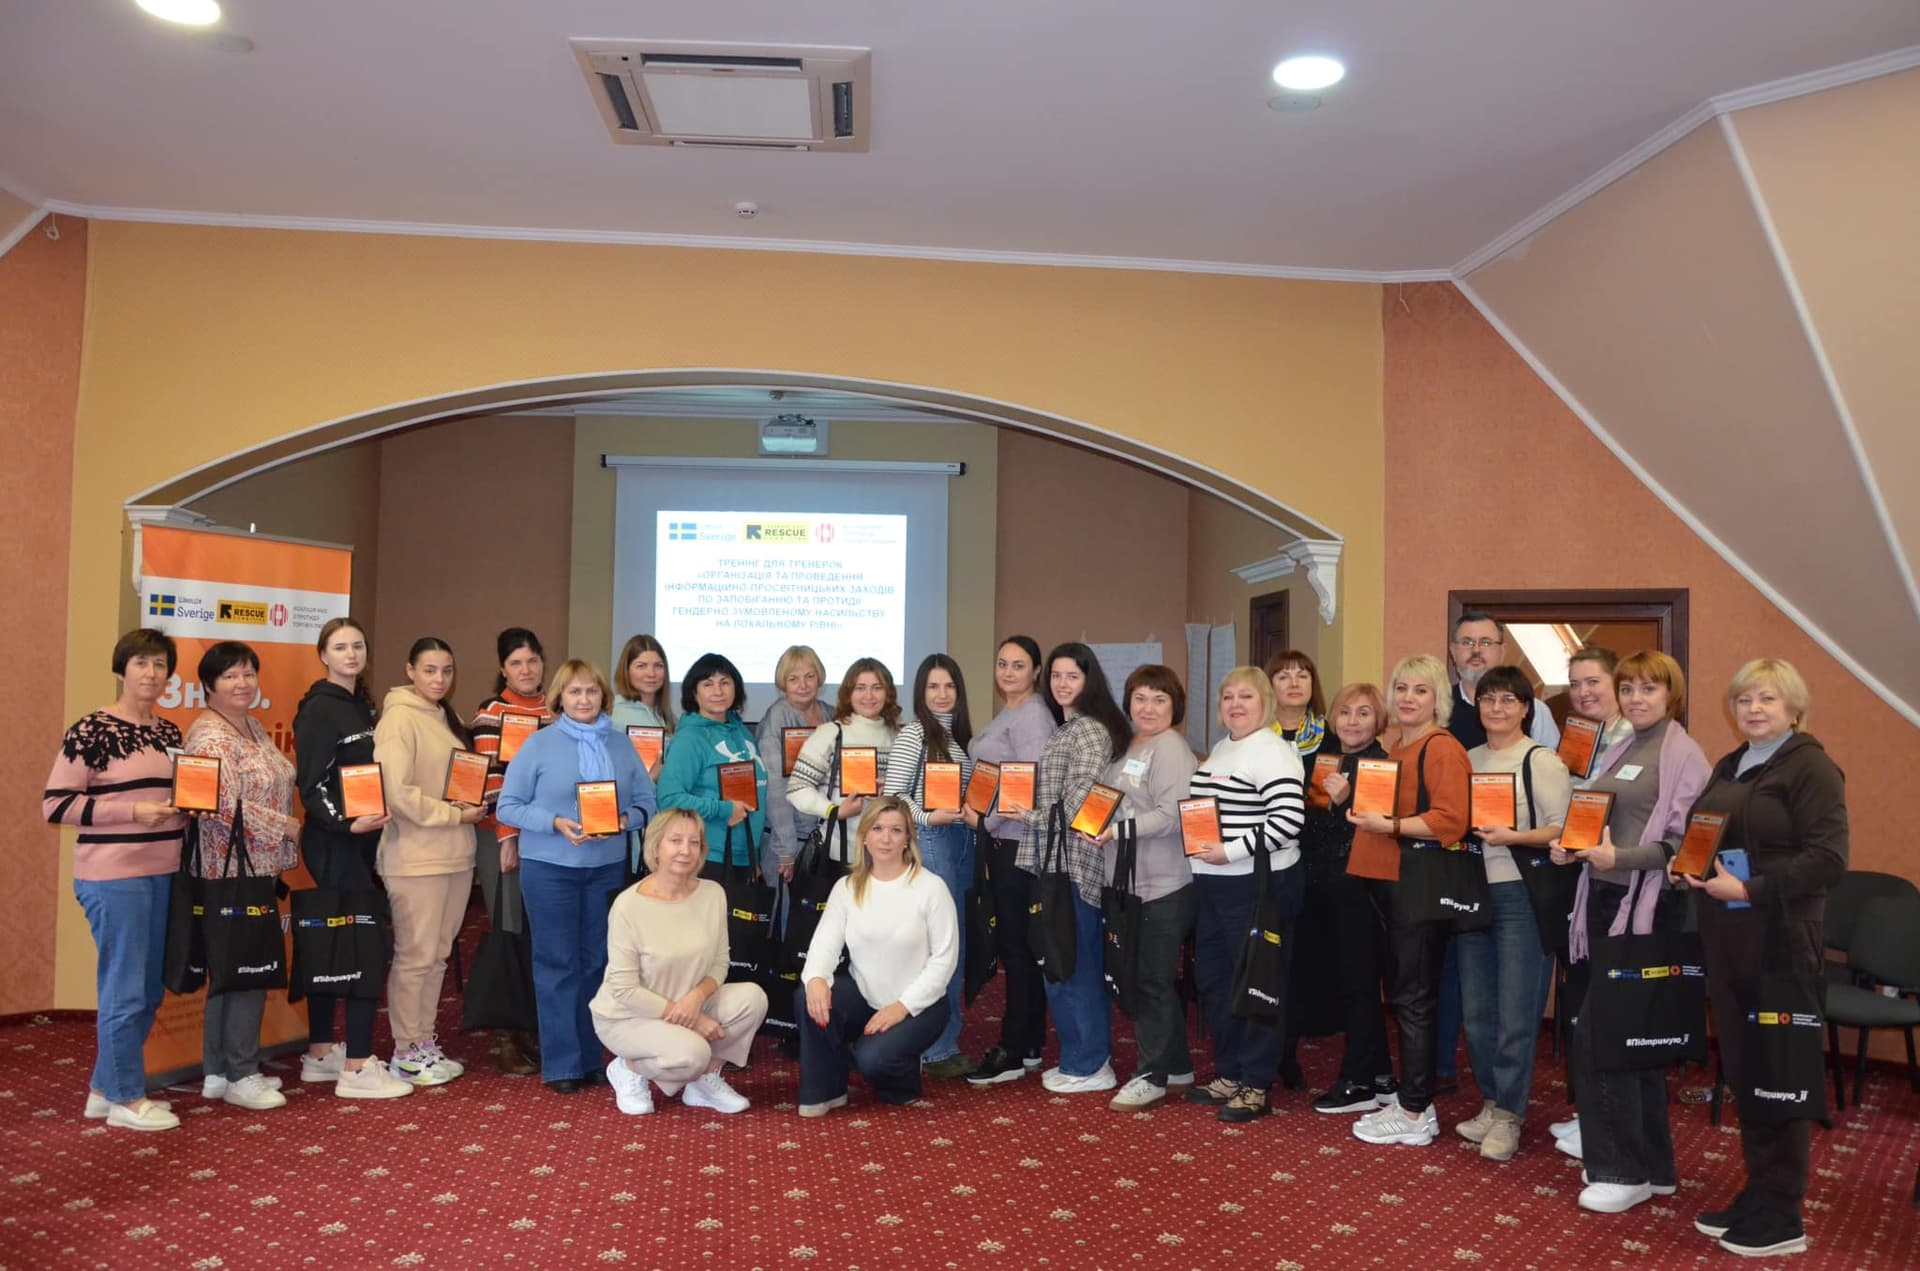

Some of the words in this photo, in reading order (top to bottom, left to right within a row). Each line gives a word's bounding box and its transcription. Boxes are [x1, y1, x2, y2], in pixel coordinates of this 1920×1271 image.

[765, 528, 806, 537] RESCUE
[719, 559, 759, 568] ТРЕНІНГ
[763, 559, 786, 569] ДЛЯ
[789, 560, 843, 569] ТРЕНЕРОК
[776, 572, 789, 580] ТА
[791, 572, 864, 581] ПРОВЕДЕННЯ
[849, 585, 895, 595] ЗАХОДІВ
[698, 594, 713, 604] ПО
[716, 595, 793, 604] ЗАПОБІГАННЮ
[797, 596, 810, 605] ТА
[177, 606, 214, 622] Sverige
[234, 608, 265, 618] RESCUE
[672, 606, 729, 616] ГЕНДЕРНО
[731, 607, 811, 617] ЗУМОВЛЕНОМУ
[815, 608, 886, 618] НАСИЛЬСТВУ
[715, 619, 731, 628] НА
[733, 619, 807, 629] ЛОКАЛЬНОМУ
